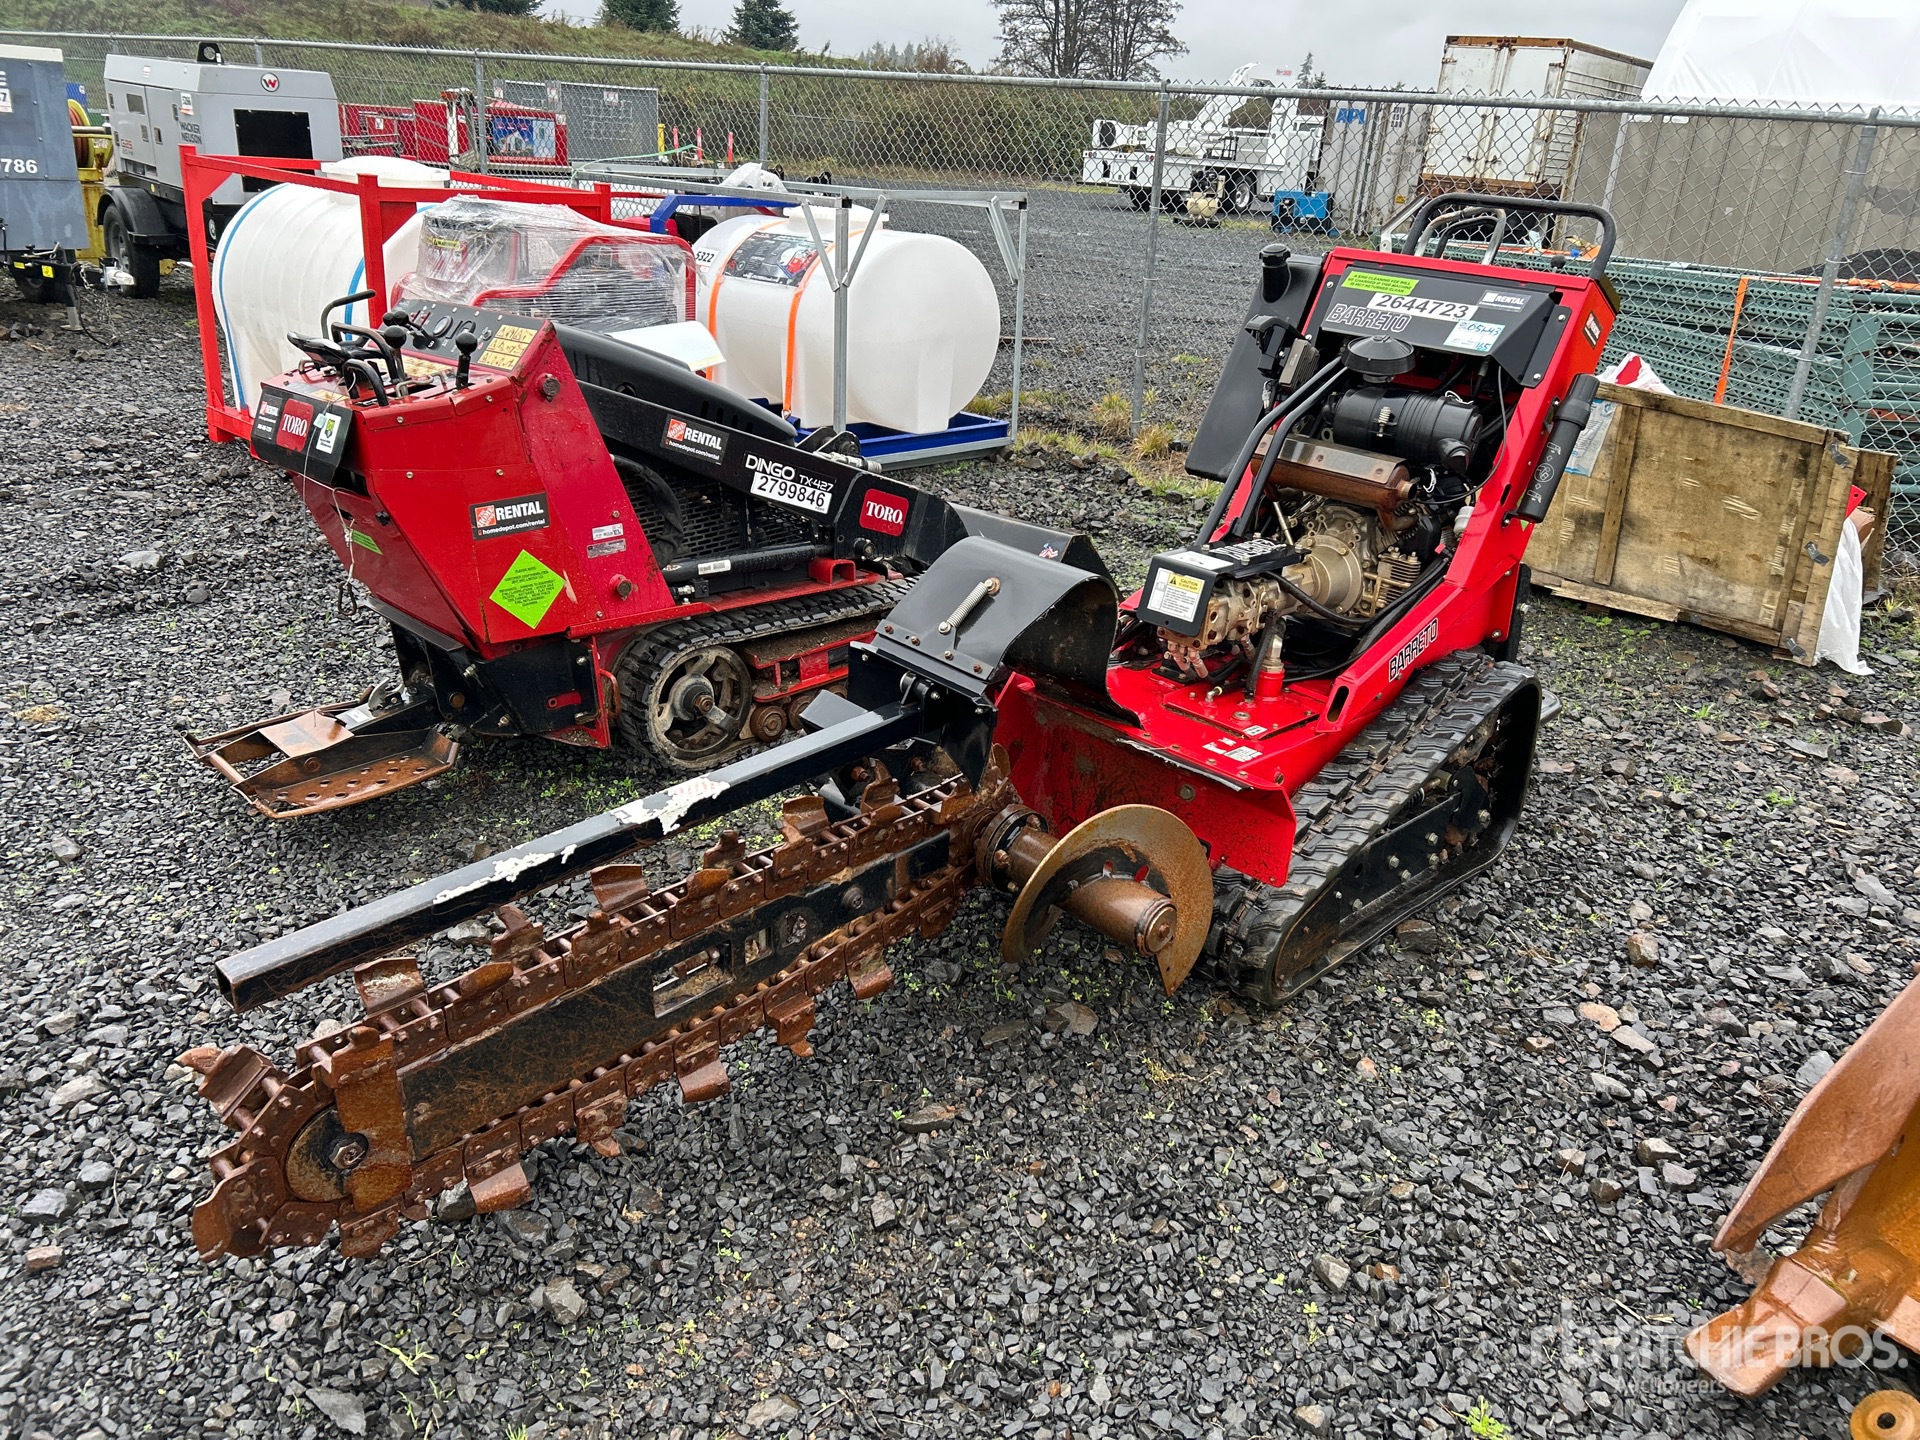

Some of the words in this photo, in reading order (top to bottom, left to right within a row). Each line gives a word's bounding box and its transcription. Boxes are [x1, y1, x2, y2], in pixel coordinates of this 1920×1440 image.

[179, 121, 201, 134] WACKER
[181, 132, 203, 145] NEUSON
[1375, 294, 1470, 319] 2644723
[1495, 295, 1525, 305] RENTAL
[1325, 303, 1412, 333] BARRETO
[282, 413, 306, 437] TORO
[669, 440, 720, 461] homedepot.com/rental
[684, 427, 722, 451] RENTAL
[745, 454, 796, 480] DINGO
[757, 475, 827, 507] 2799846
[495, 500, 544, 522] RENTAL
[866, 501, 903, 524] TORO
[482, 519, 545, 536] homedepot.com/rental
[1180, 578, 1198, 587] CAUTION
[1388, 617, 1439, 683] BARRETO
